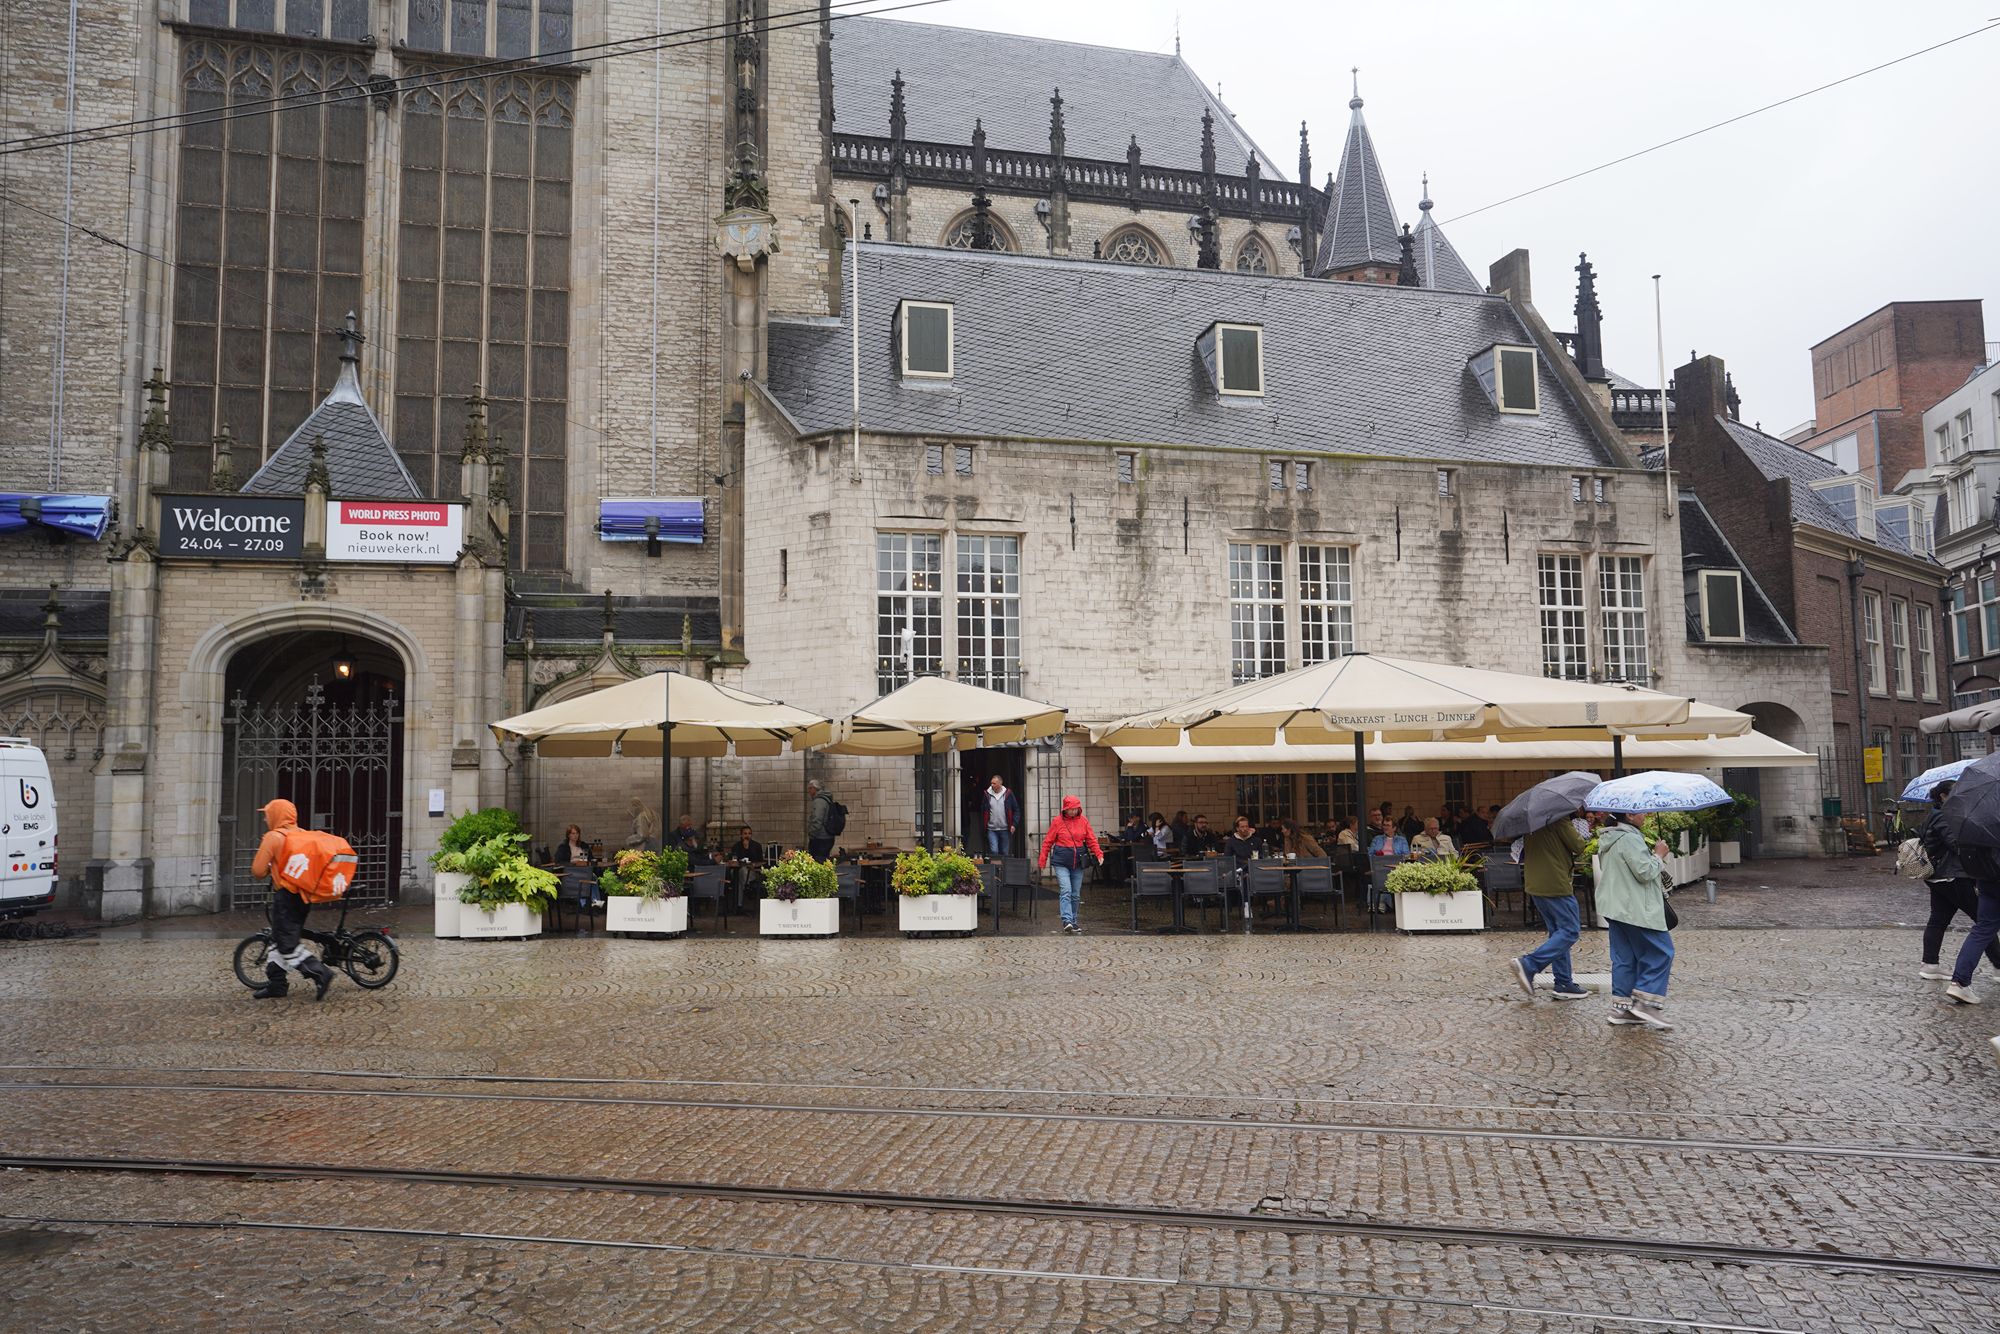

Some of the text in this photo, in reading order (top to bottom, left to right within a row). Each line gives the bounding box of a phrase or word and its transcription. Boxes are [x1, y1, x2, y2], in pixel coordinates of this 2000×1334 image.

[173, 508, 291, 533] Welcome
[349, 509, 441, 521] WORLD PRESS PHOTO
[359, 530, 429, 541] Book now!
[180, 537, 223, 550] 24.04
[244, 539, 284, 551] 27.09
[347, 542, 441, 555] nieuwekerk.nl
[1331, 715, 1385, 725] BREAKFAST
[1394, 713, 1428, 723] LUNCH
[1437, 712, 1476, 722] DINNER
